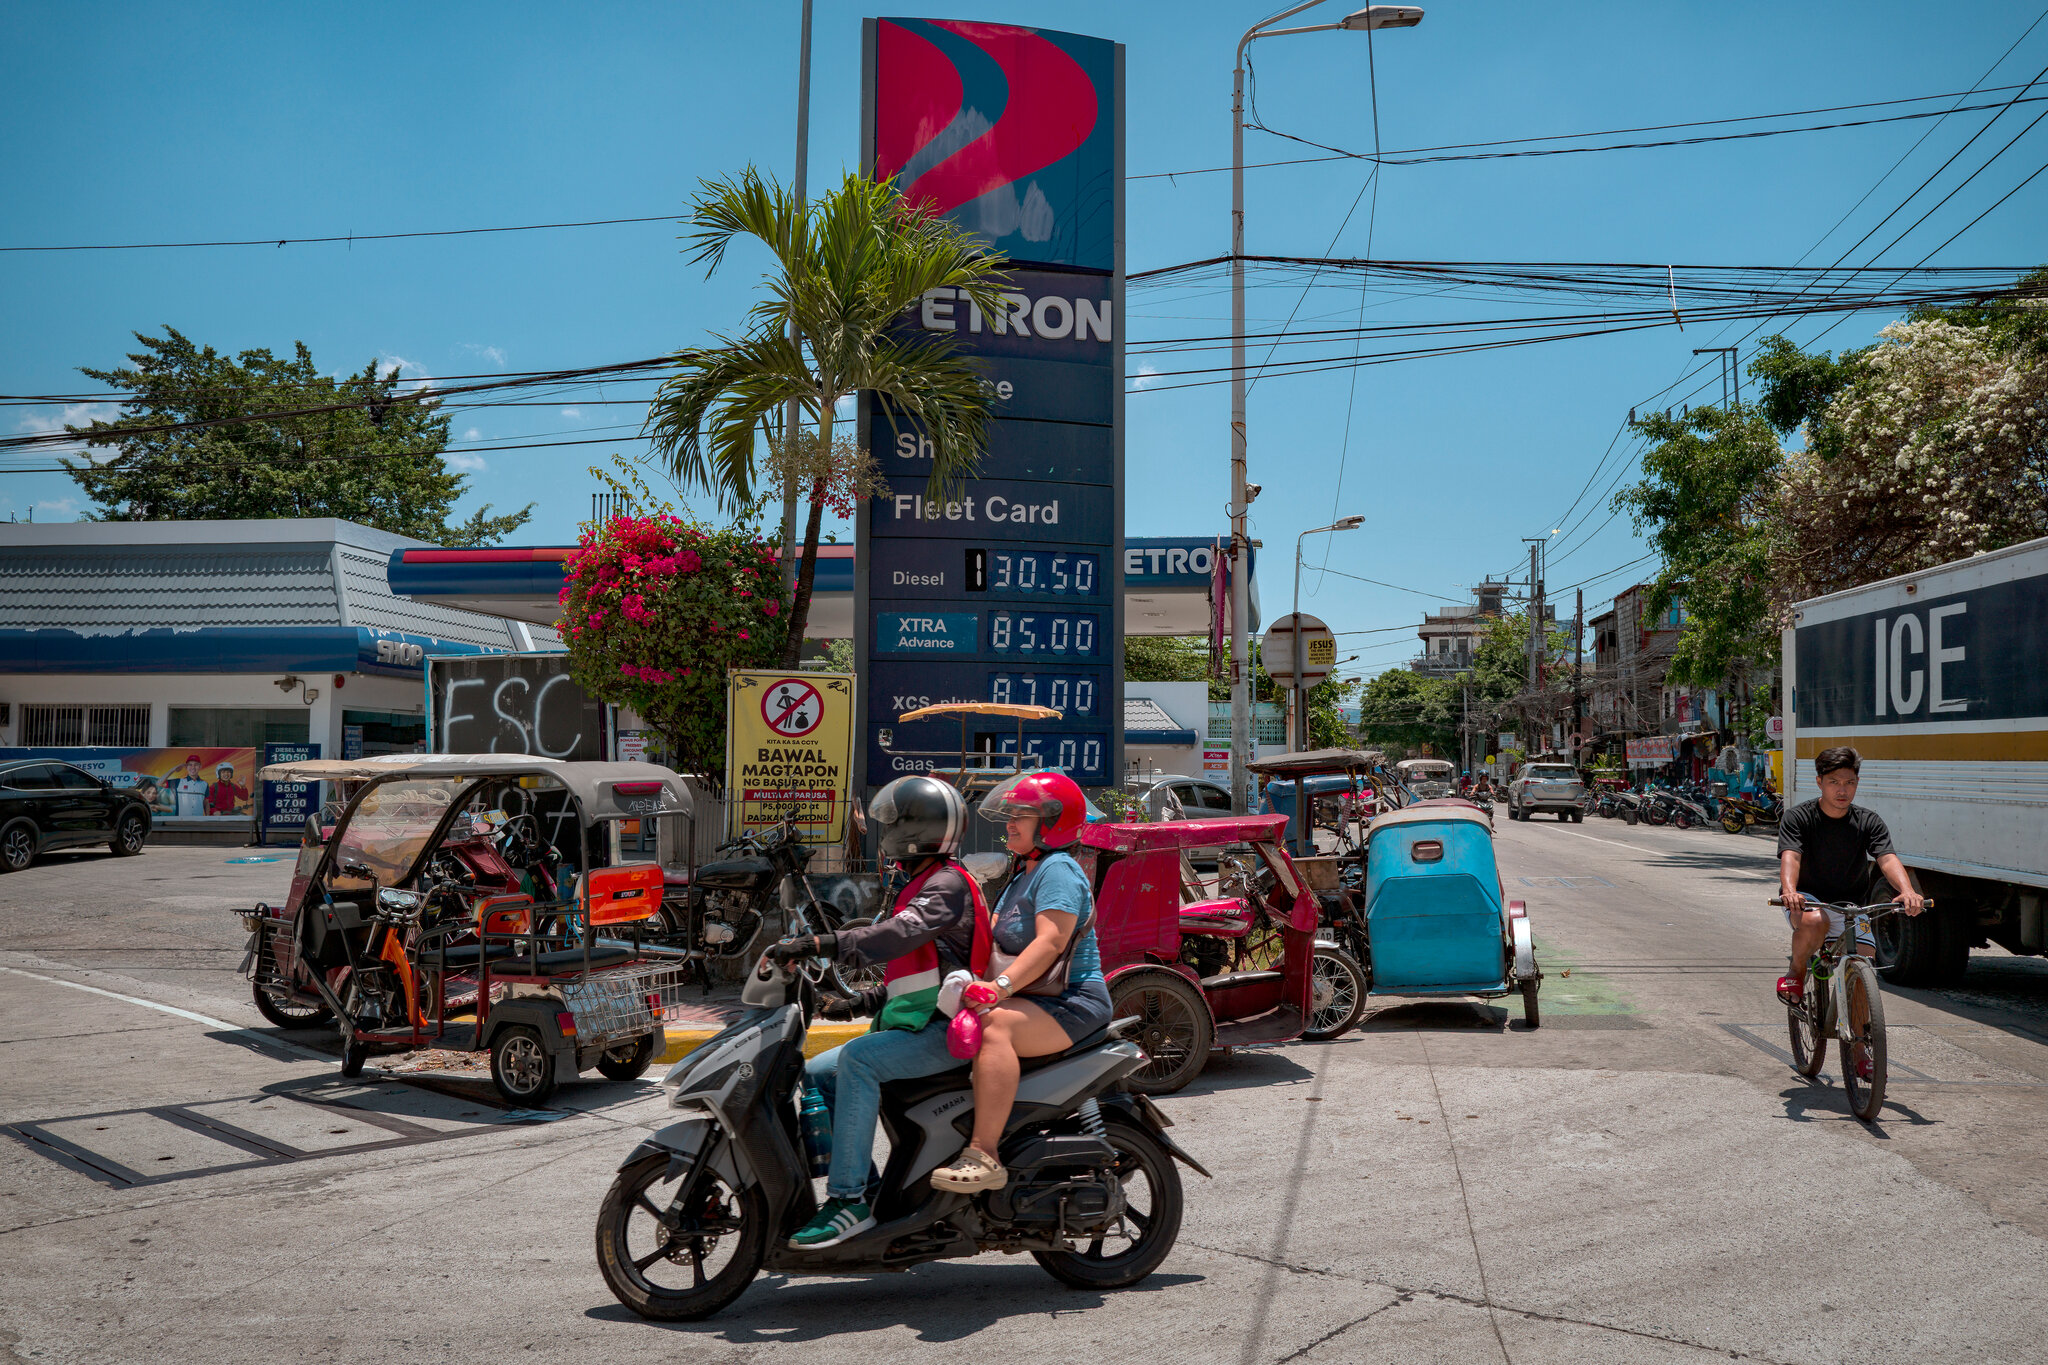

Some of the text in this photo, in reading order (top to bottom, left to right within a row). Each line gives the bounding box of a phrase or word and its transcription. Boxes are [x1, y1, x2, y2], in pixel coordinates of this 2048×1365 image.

[921, 288, 1112, 343] ETRON
[895, 494, 1058, 524] Fleet Card
[1125, 548, 1231, 575] ETRO
[893, 571, 944, 586] Diesel
[898, 618, 947, 633] XTRA
[898, 616, 1093, 650] Advance 85.00
[1308, 640, 1333, 649] JESUS
[376, 639, 424, 666] SHOP
[1875, 602, 1968, 716] ICE
[892, 695, 930, 710] XCS
[758, 748, 827, 763] BAWAL
[742, 764, 839, 777] MAGTAPON
[892, 757, 935, 771] Gaas
[743, 778, 760, 787] NG
[763, 778, 806, 787] BASURA
[753, 791, 827, 799] MULTA AT PARUSA
[932, 1095, 966, 1117] YAMAHA
